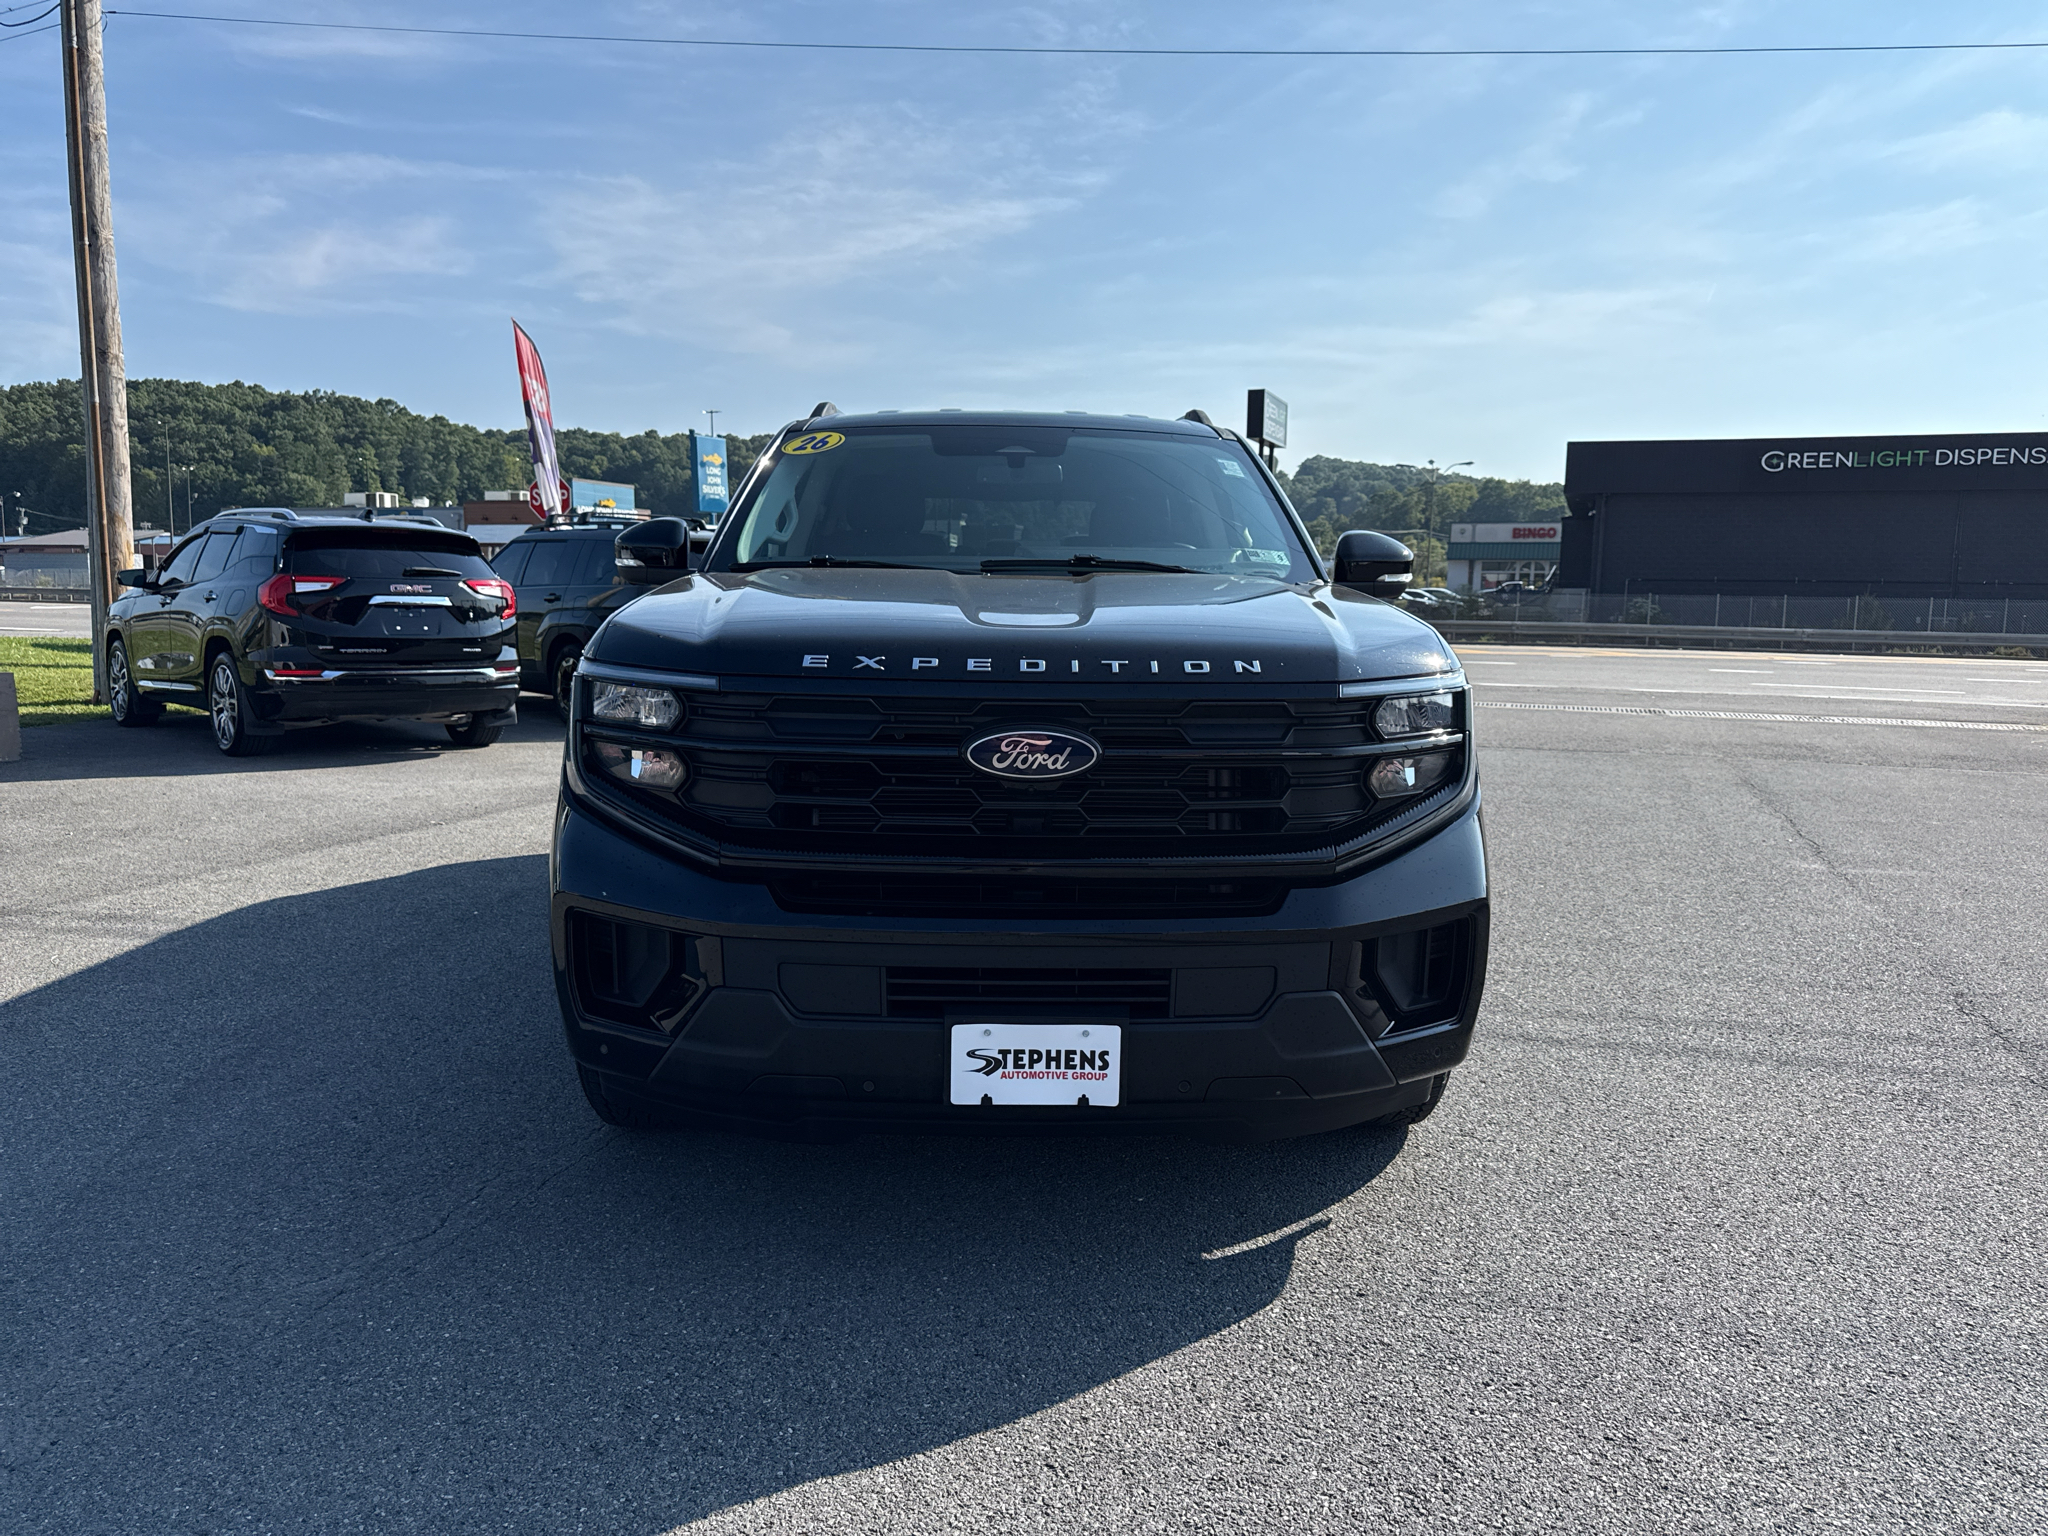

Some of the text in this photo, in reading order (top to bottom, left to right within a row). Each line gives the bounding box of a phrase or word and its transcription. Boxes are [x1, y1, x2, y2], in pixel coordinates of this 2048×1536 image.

[793, 434, 832, 451] 26
[1761, 446, 2048, 473] GREENLIGHT DISPENS
[706, 466, 722, 476] LONG
[707, 476, 722, 485] JOHN
[532, 488, 568, 506] SP
[1512, 527, 1557, 539] BINGO
[389, 584, 433, 593] GMC
[801, 654, 1262, 674] EXPEDITION
[991, 737, 1071, 771] Ford
[962, 1048, 1110, 1077] STEPHENS
[1000, 1071, 1108, 1081] AUTOMOTIVE GROUP
